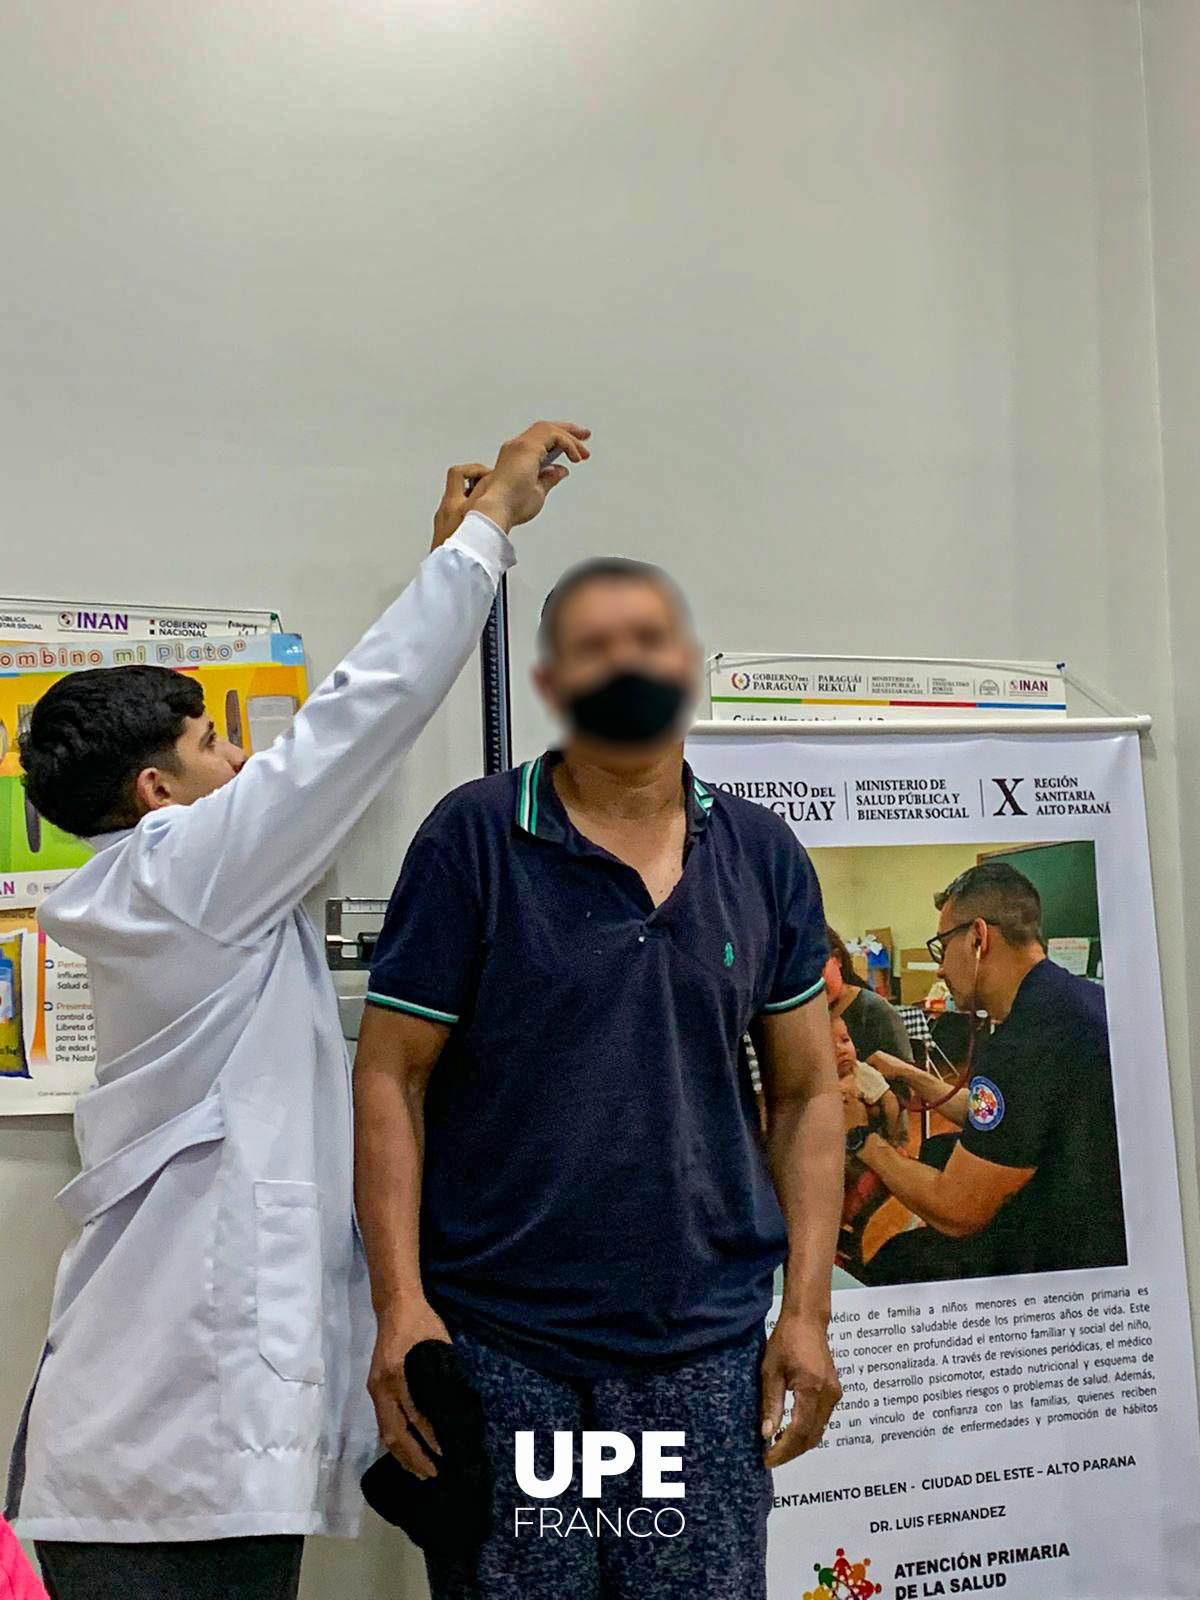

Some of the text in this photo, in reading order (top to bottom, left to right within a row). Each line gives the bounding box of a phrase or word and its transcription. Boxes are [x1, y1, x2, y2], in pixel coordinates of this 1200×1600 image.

[77, 612, 128, 630] INAN
[159, 619, 208, 630] GOBIERNO
[159, 628, 208, 638] NACIONAL
[114, 645, 146, 664] mi
[752, 673, 798, 682] GOBIERNO
[753, 681, 809, 692] PARAGUAY
[1019, 680, 1048, 692] INAN
[708, 780, 836, 799] OBIERNO DEL
[856, 779, 946, 791] MINISTERIO DE
[1034, 775, 1078, 788] REGIÓN
[856, 792, 960, 806] SALUD PÚBLICA Y
[991, 778, 1028, 816] X
[1035, 790, 1096, 802] SANITARIA
[768, 801, 836, 822] GUAY
[857, 807, 970, 820] BIENESTAR SOCIAL
[1036, 802, 1112, 816] ALTO PARANÁ
[57, 982, 80, 990] Salud
[56, 1054, 70, 1062] Pre
[868, 1310, 880, 1320] de
[888, 1306, 921, 1318] familia
[929, 1306, 934, 1315] a
[942, 1302, 968, 1314] niños
[976, 1298, 1017, 1310] menores
[1024, 1296, 1036, 1306] en
[1043, 1292, 1084, 1304] atención
[1091, 1286, 1130, 1302] primaria
[1137, 1286, 1149, 1296] es
[840, 1331, 852, 1341] un
[856, 1324, 906, 1339] desarrollo
[911, 1319, 958, 1334] saludable
[962, 1316, 991, 1329] desde
[994, 1315, 1009, 1326] los
[1013, 1310, 1056, 1326] primeros
[1060, 1306, 1083, 1320] años
[1087, 1306, 1099, 1317] de
[1103, 1302, 1126, 1316] vida.
[1130, 1302, 1150, 1314] Este
[853, 1344, 892, 1357] conocer
[897, 1342, 910, 1352] en
[914, 1335, 973, 1352] profundidad
[976, 1333, 986, 1344] el
[989, 1330, 1028, 1343] entorno
[1031, 1327, 1066, 1339] familiar
[1070, 1328, 1076, 1338] y
[1080, 1322, 1106, 1336] social
[1109, 1320, 1124, 1332] del
[1128, 1318, 1152, 1330] niño,
[858, 1365, 864, 1376] y
[867, 1354, 938, 1374] personalizada.
[942, 1355, 950, 1366] A
[952, 1350, 982, 1364] través
[984, 1350, 997, 1362] de
[1000, 1346, 1048, 1359] revisiones
[1051, 1340, 1103, 1356] periódicas,
[1106, 1338, 1115, 1350] el
[1118, 1335, 1153, 1348] médico
[873, 1374, 924, 1390] desarrollo
[928, 1370, 985, 1386] psicomotor,
[990, 1365, 1023, 1378] estado
[1028, 1358, 1079, 1374] nutricional
[1084, 1360, 1090, 1370] y
[1094, 1354, 1137, 1369] esquema
[1142, 1352, 1154, 1363] de
[874, 1398, 880, 1408] a
[884, 1394, 919, 1408] tiempo
[922, 1388, 962, 1404] posibles
[966, 1384, 1000, 1400] riesgos
[1002, 1385, 1010, 1394] o
[1014, 1378, 1064, 1396] problemas
[1067, 1376, 1080, 1387] de
[1082, 1374, 1110, 1386] salud.
[1114, 1368, 1156, 1382] Además,
[849, 1417, 862, 1428] un
[869, 1411, 905, 1426] vínculo
[912, 1410, 926, 1421] de
[932, 1404, 978, 1419] confianza
[985, 1402, 1003, 1412] con
[1010, 1398, 1024, 1410] las
[1030, 1396, 1070, 1408] familias,
[1077, 1390, 1115, 1404] quienes
[1121, 1386, 1157, 1399] reciben
[836, 1433, 875, 1447] crianza,
[880, 1427, 936, 1444] prevención
[942, 1424, 954, 1436] de
[960, 1416, 1030, 1434] enfermedades
[1034, 1416, 1042, 1426] y
[1047, 1410, 1100, 1425] promoción
[1105, 1406, 1117, 1418] de
[1123, 1402, 1158, 1416] hábitos
[864, 1481, 907, 1498] BELEN
[922, 1474, 972, 1490] CIUDAD
[976, 1470, 1001, 1484] DEL
[1004, 1466, 1035, 1480] ESTE
[1046, 1462, 1080, 1476] ALTO
[1083, 1455, 1136, 1472] PARANA
[870, 1506, 1006, 1534] DR. LUIS FERNANDEZ
[894, 1542, 1070, 1580] ATENCIÓN PRIMARIA
[896, 1572, 1006, 1600] DE LA SALUD
